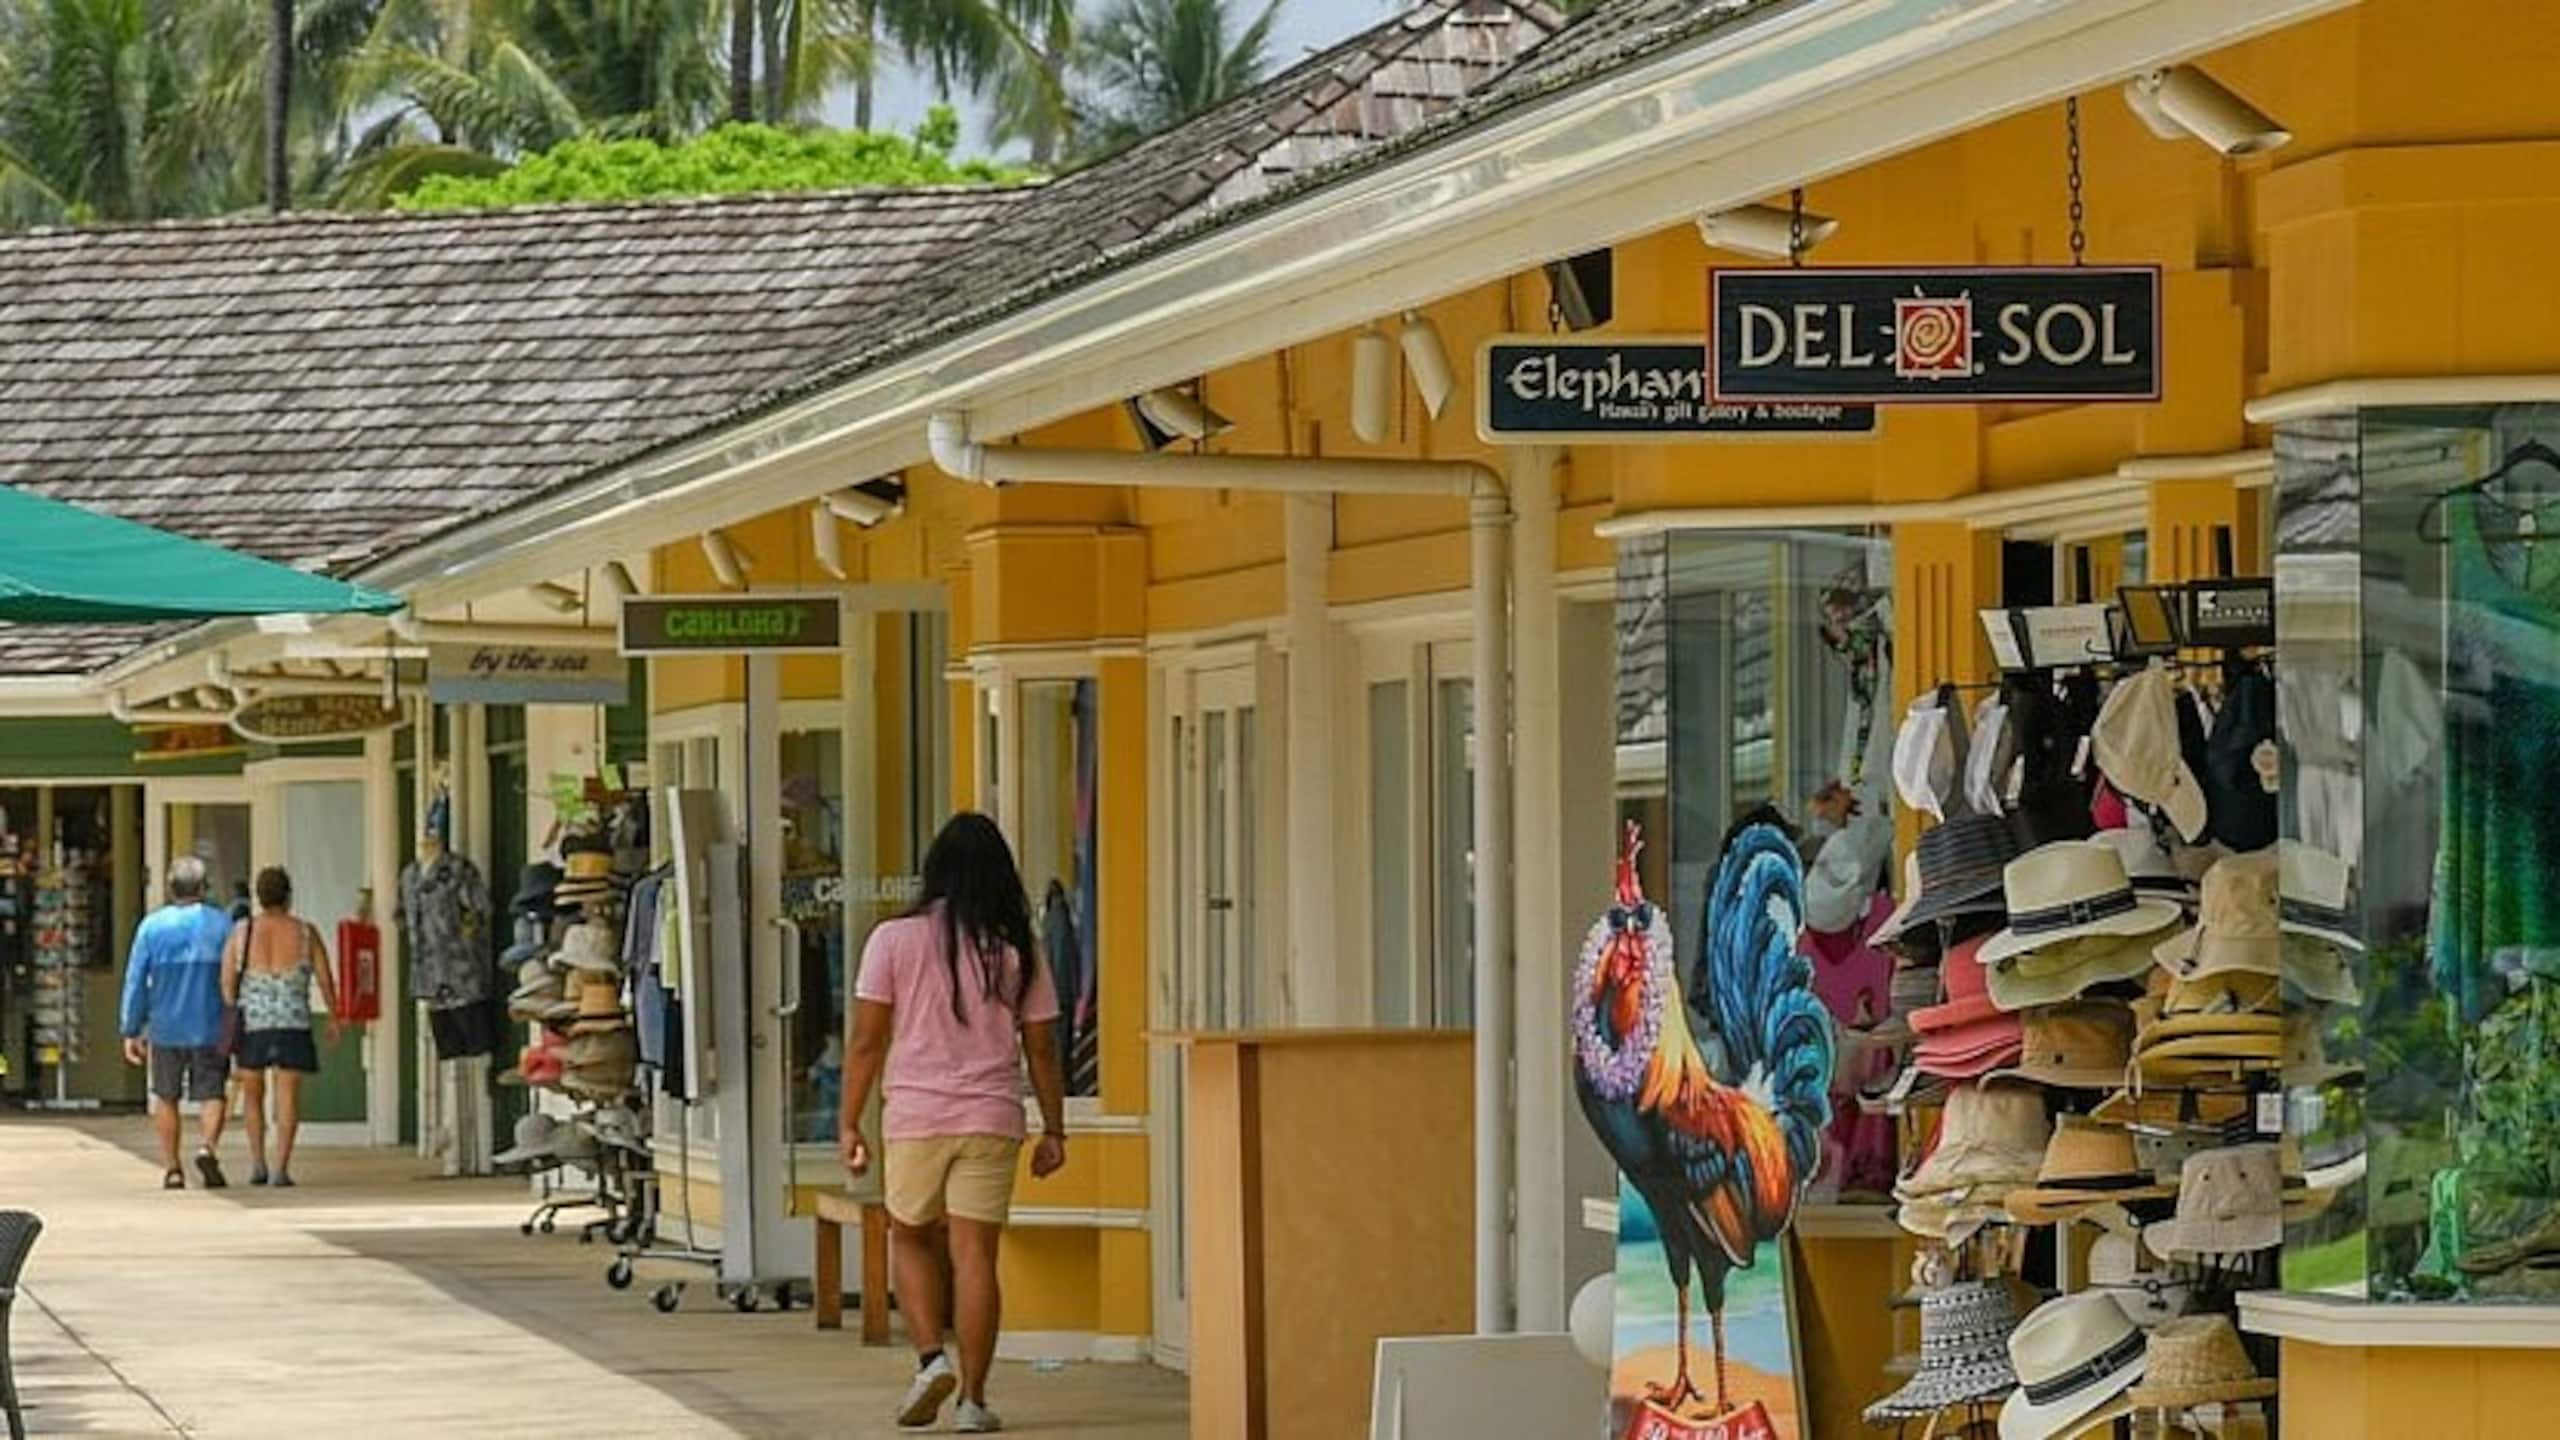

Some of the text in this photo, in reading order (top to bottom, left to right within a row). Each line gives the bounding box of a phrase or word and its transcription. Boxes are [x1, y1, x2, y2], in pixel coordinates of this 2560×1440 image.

[1739, 303, 2137, 368] DEL SOL
[1505, 352, 1707, 411] Elephan
[1664, 402, 1693, 425] gift
[1753, 405, 1769, 418] &
[468, 645, 591, 681] by the sea
